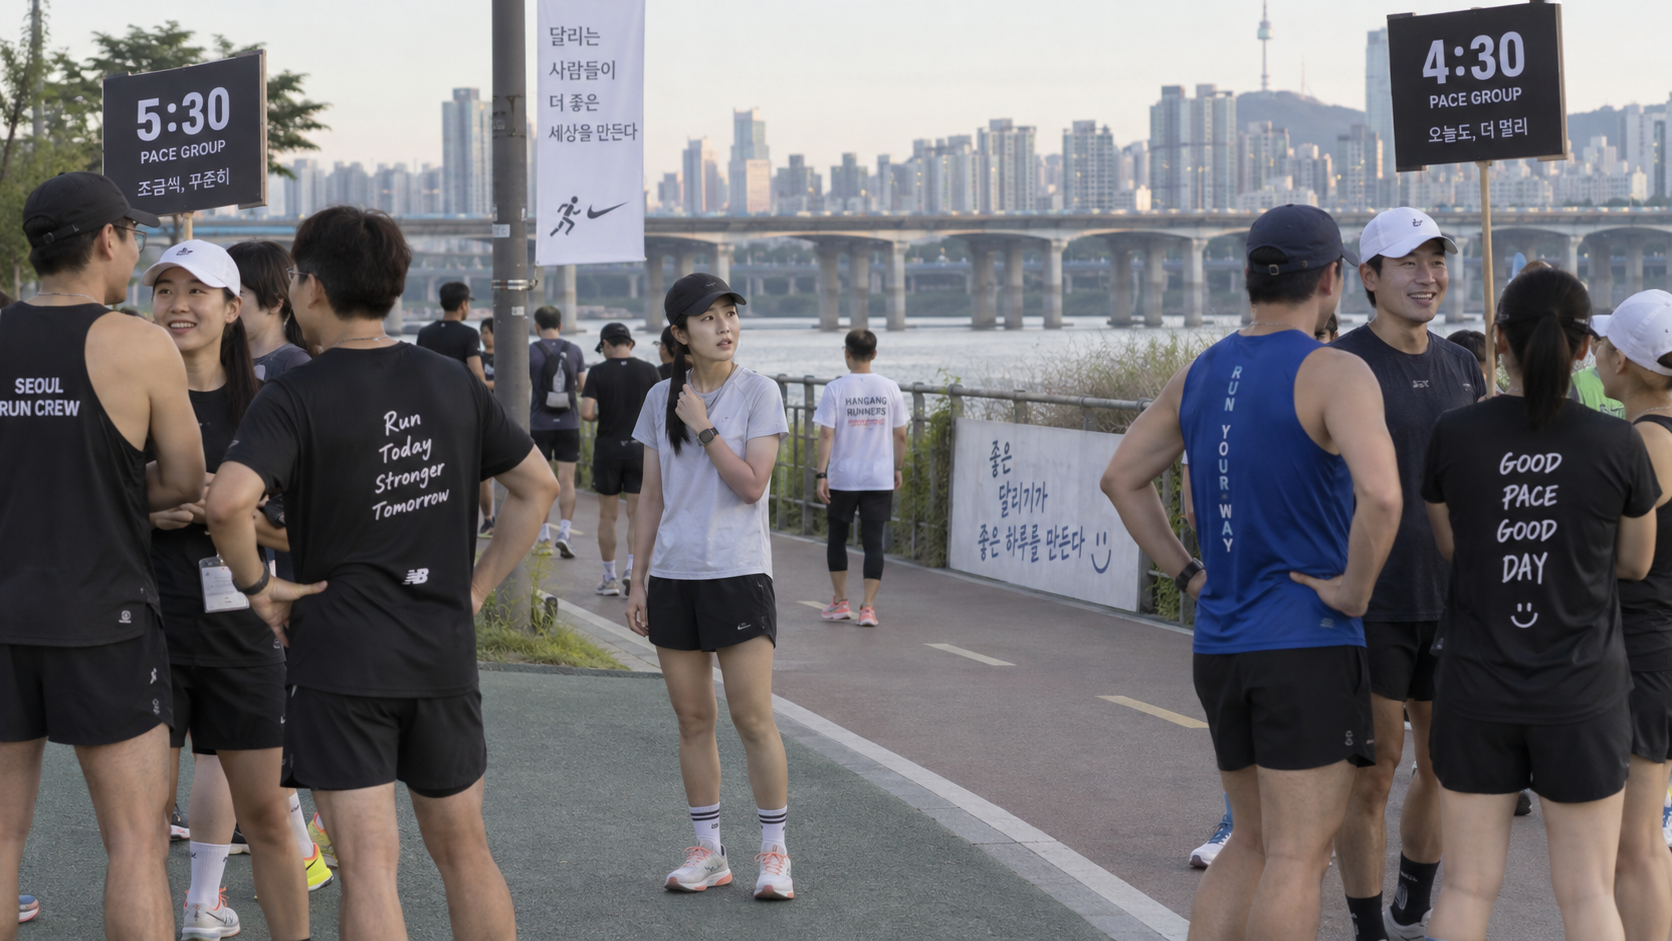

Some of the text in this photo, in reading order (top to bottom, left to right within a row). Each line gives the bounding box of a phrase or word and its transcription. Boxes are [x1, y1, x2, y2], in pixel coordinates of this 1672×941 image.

[549, 26, 600, 46] 달리는
[549, 60, 616, 80] 사람들이
[1422, 31, 1525, 84] 4:30
[549, 93, 600, 112] 더 좋은
[1429, 87, 1522, 109] PACE GROUP
[136, 86, 230, 141] 5:30
[549, 122, 638, 143] 세상을 만든다
[1428, 117, 1528, 143] 오늘도, 더 멀리
[140, 140, 226, 164] PACE GROUP
[137, 167, 230, 197] 조금씩, 꾸준히
[14, 377, 64, 394] SEOUL
[0, 400, 80, 417] RUN CREW
[845, 396, 887, 406] HANGANG
[846, 407, 886, 417] RUNNERS
[383, 410, 421, 436] Run
[378, 435, 432, 464] Today
[989, 440, 1012, 478] 좋은
[1218, 366, 1242, 552] RUN YOUR WAY
[1499, 452, 1563, 475] GOOD
[374, 462, 445, 494] Stronger
[372, 489, 450, 521] Tomorrow
[999, 480, 1048, 519] 달리기가
[1502, 484, 1559, 511] PACE
[977, 523, 1086, 563] 좋은 하루를 만든다
[1497, 519, 1558, 543] GOOD
[1501, 551, 1549, 585] DAY
